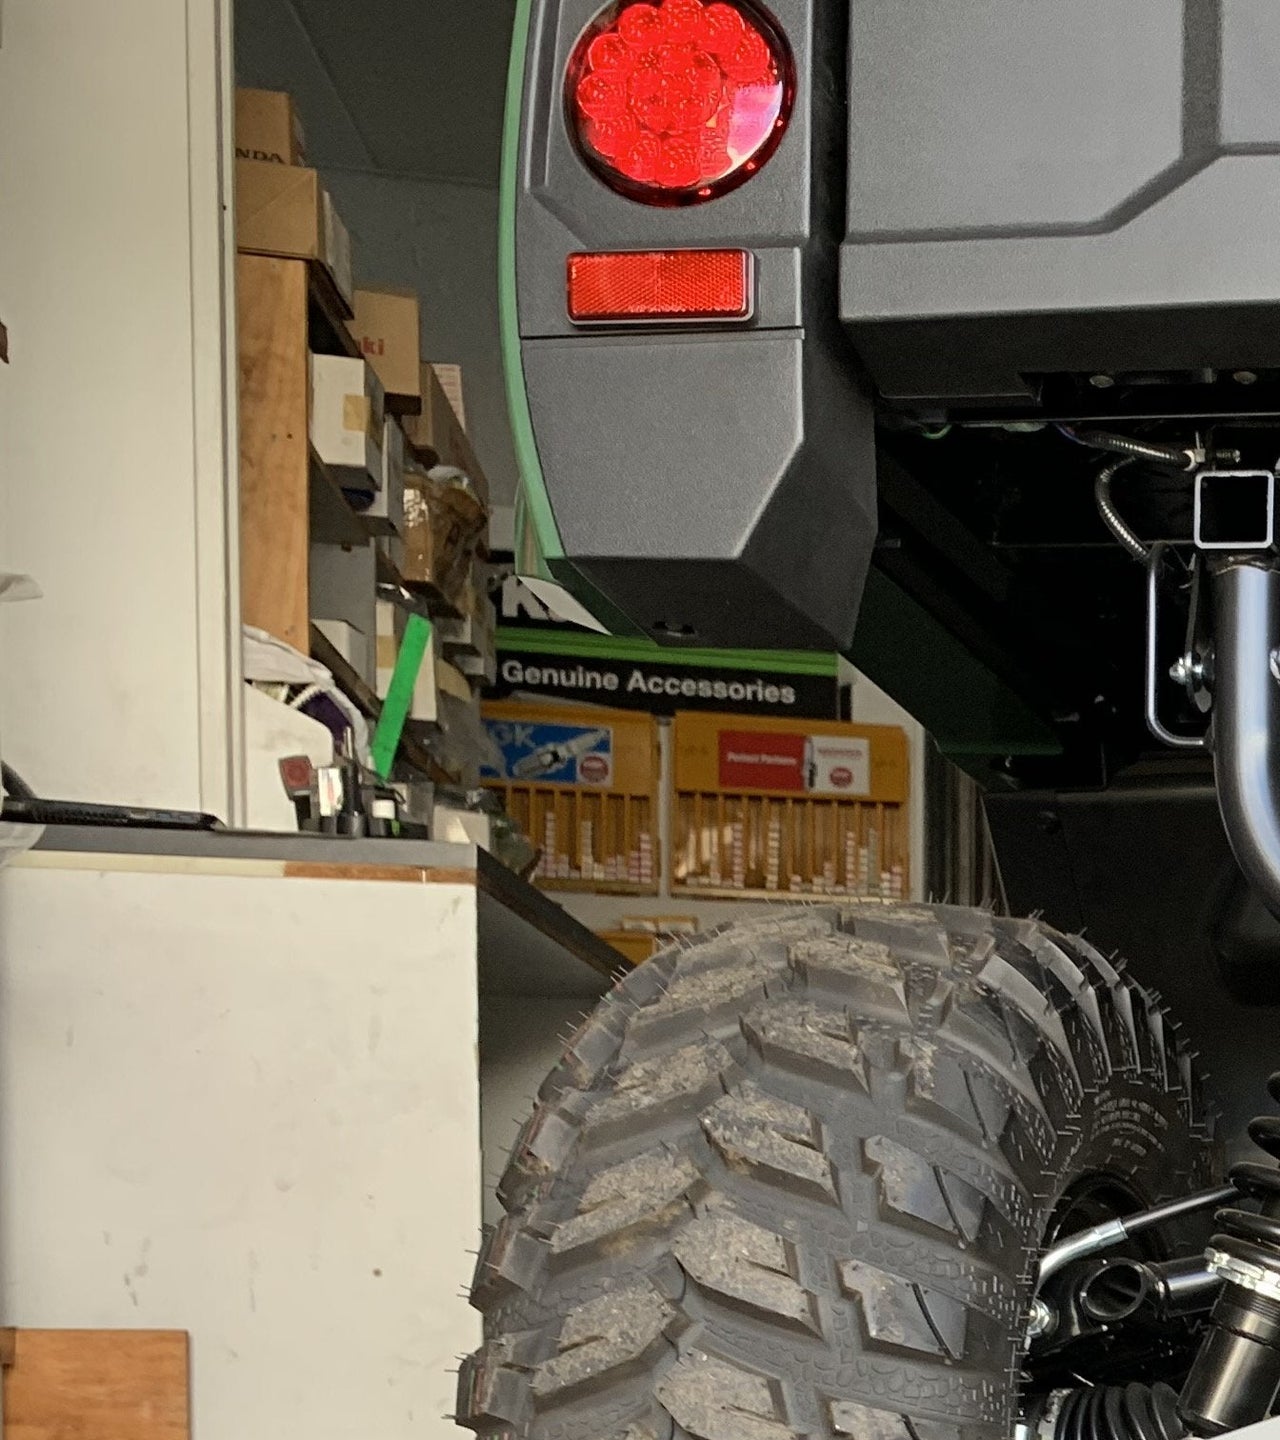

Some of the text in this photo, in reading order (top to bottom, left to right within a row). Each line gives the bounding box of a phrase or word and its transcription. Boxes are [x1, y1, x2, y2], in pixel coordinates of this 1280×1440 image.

[235, 148, 286, 165] NDA
[502, 659, 796, 705] Genuine Accessories
